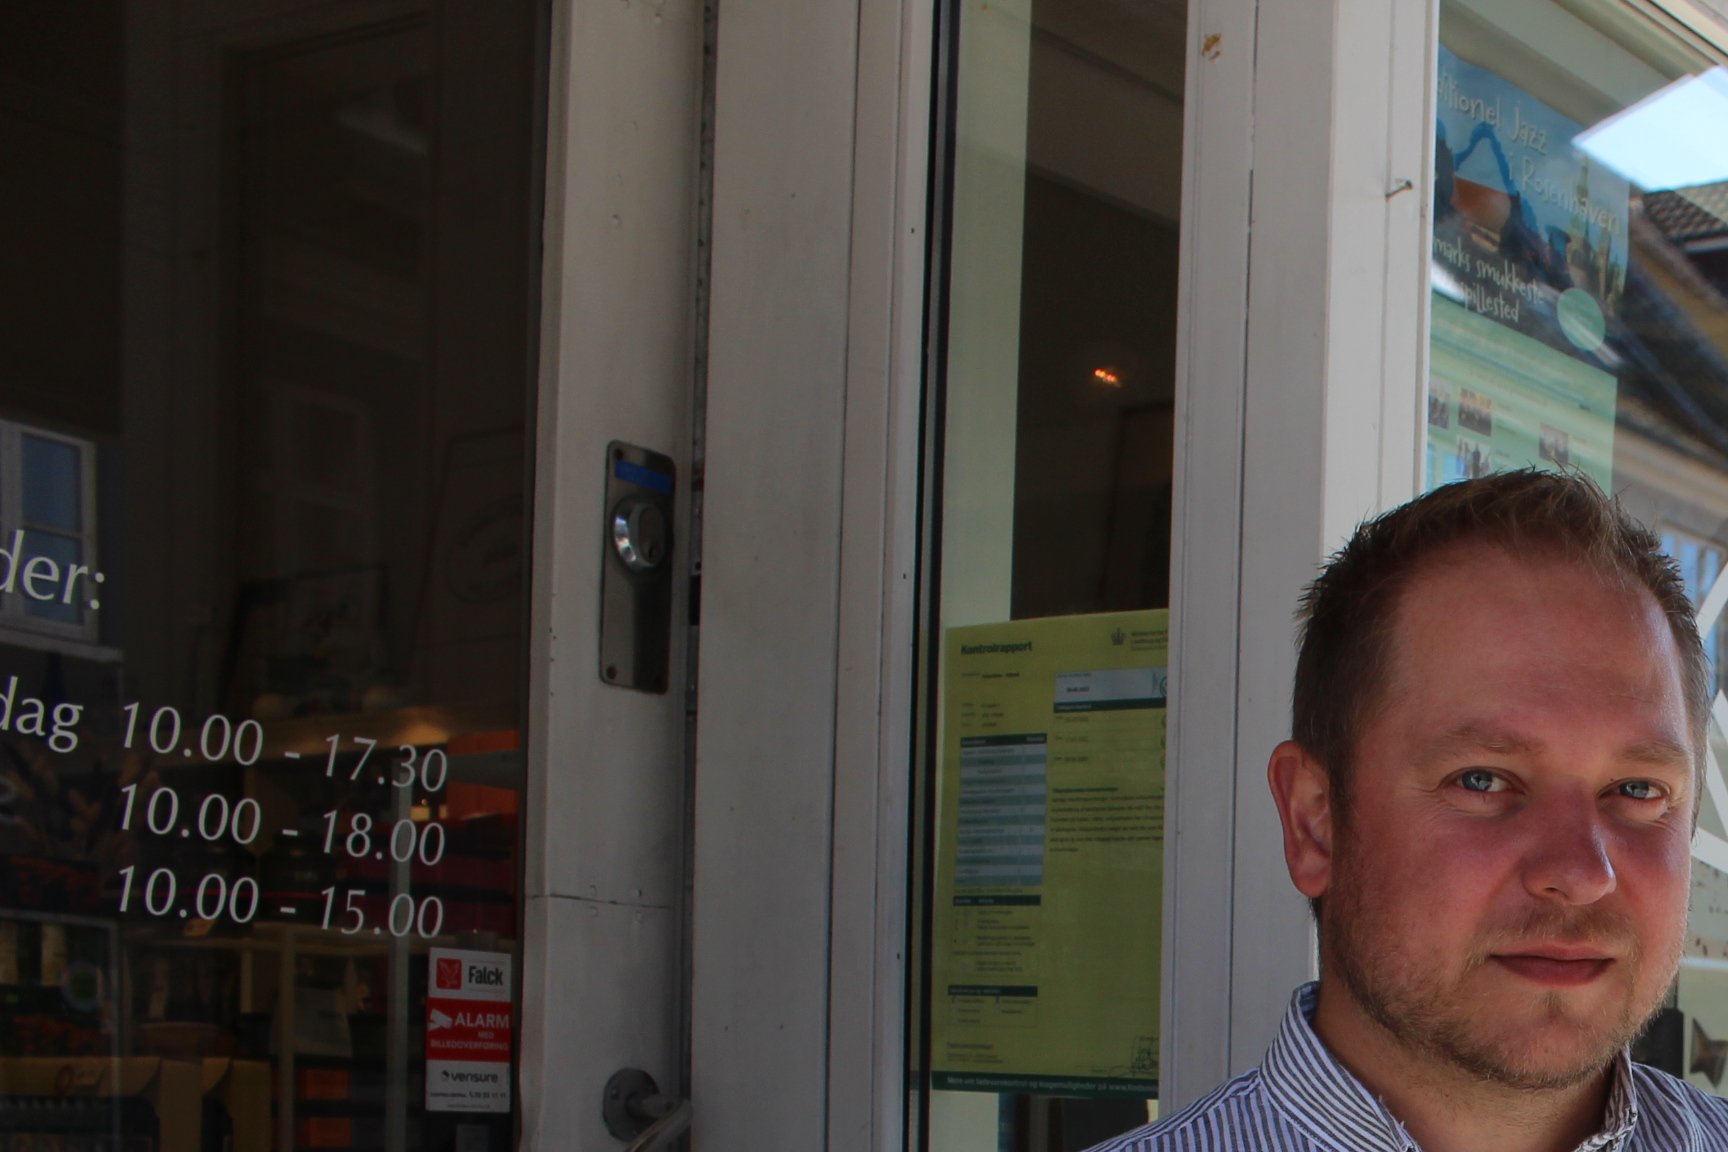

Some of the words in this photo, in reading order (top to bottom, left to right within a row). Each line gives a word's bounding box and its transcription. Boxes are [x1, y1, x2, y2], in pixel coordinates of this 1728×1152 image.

[1511, 103, 1548, 156] Jazz
[960, 641, 1032, 656] Kontrolrapport
[123, 702, 263, 766] 10.00
[324, 733, 448, 792] 17.30
[121, 783, 261, 844] 10.00
[322, 810, 445, 865] 18.00
[118, 865, 259, 923] 10.00
[320, 886, 444, 938] 15.00
[468, 965, 504, 986] Falck
[454, 1012, 510, 1029] ALARM
[451, 1071, 498, 1084] verisure
